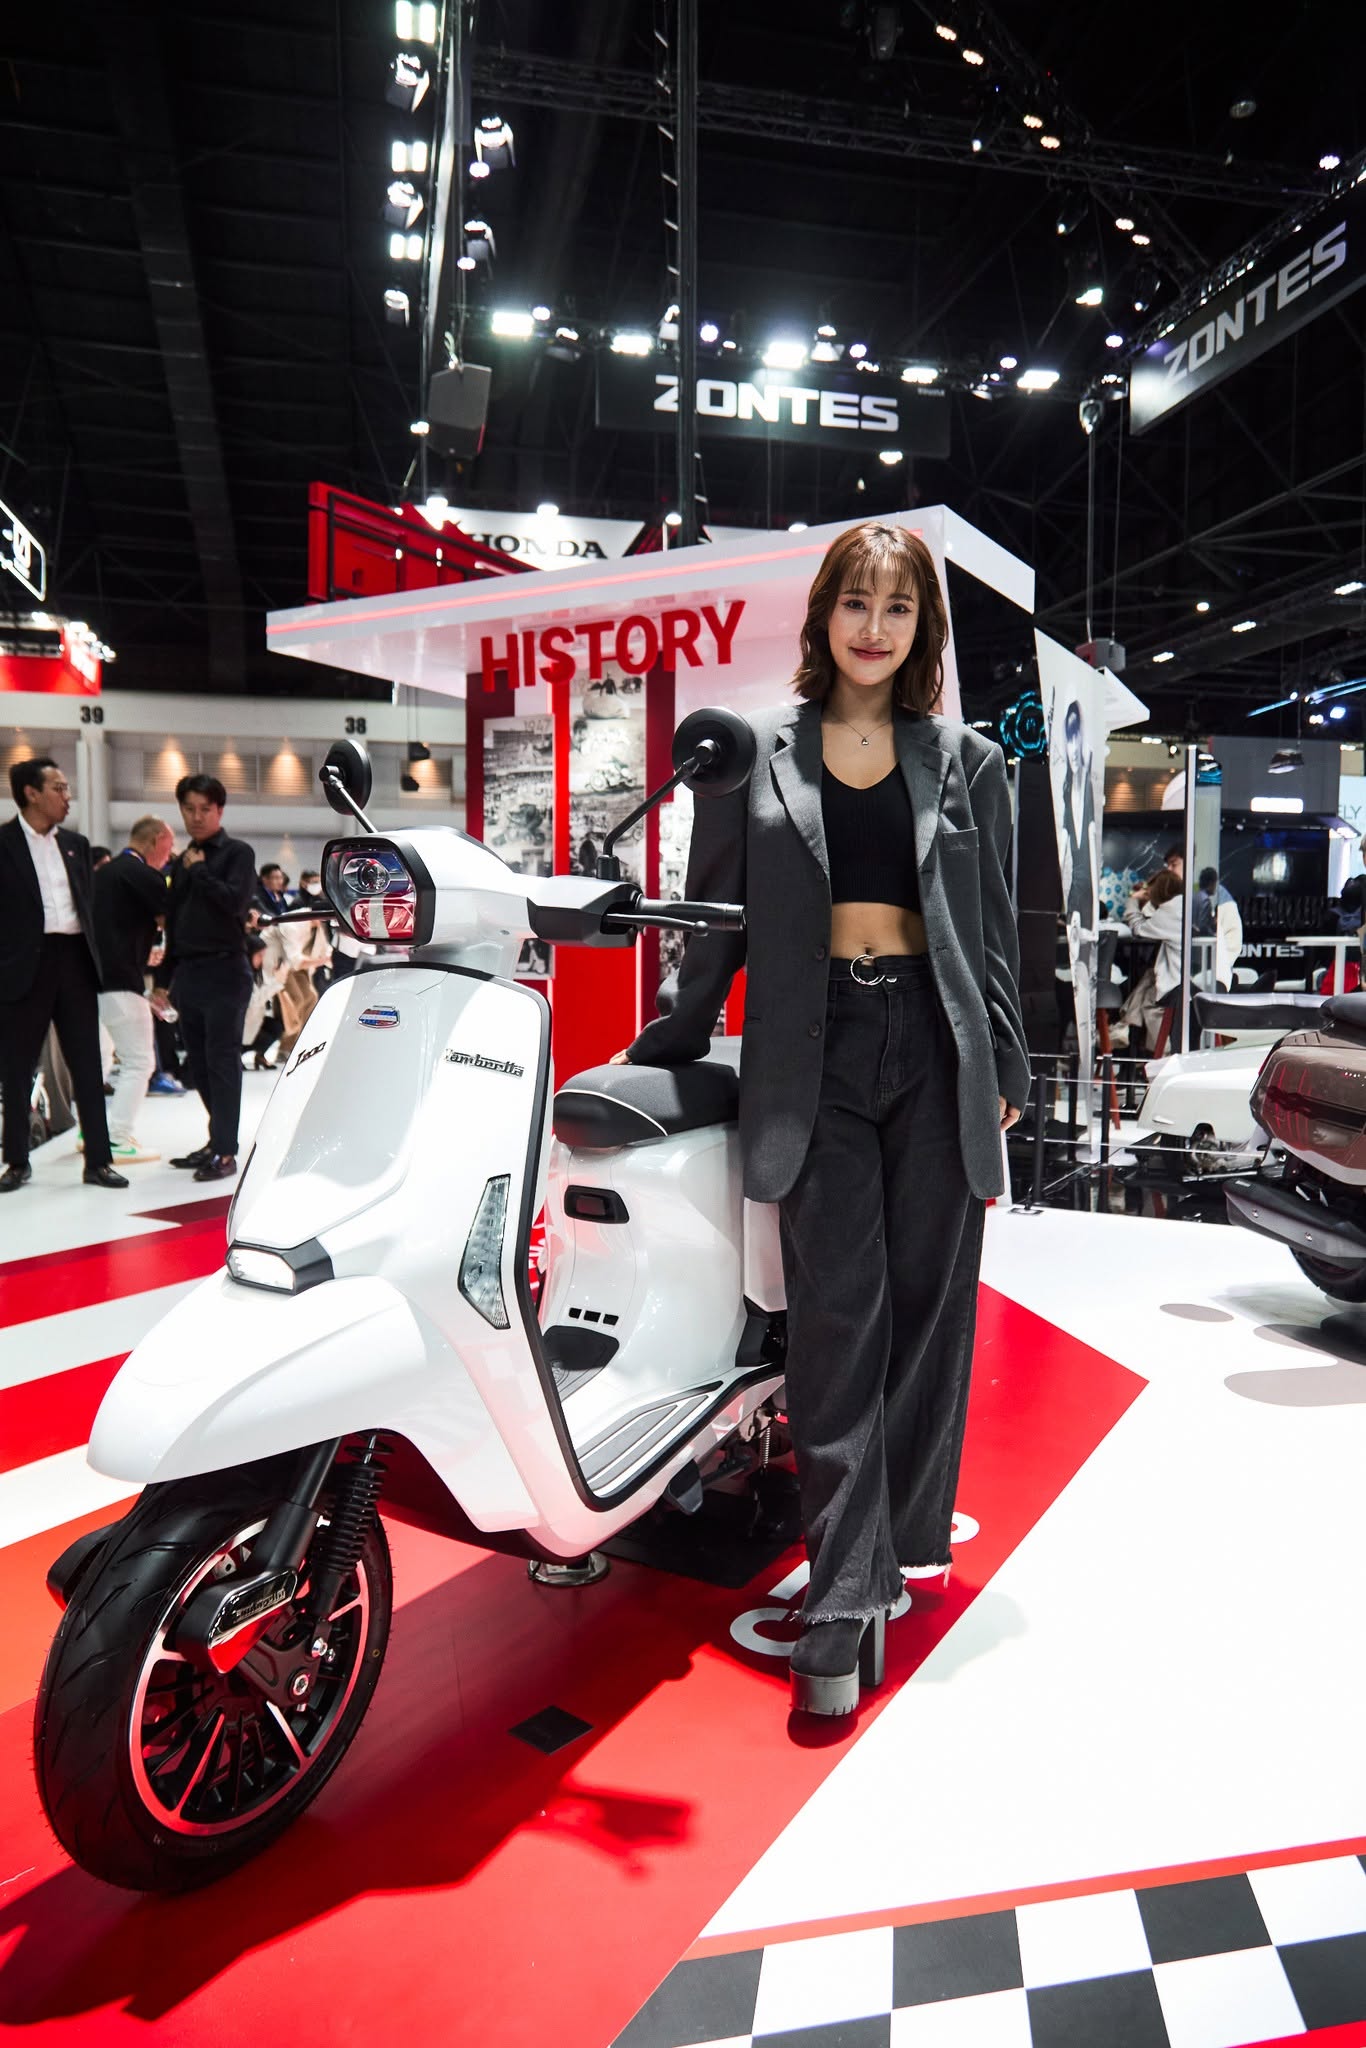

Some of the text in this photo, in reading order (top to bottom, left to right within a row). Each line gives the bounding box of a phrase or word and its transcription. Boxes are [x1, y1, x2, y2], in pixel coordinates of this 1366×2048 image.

[1163, 220, 1347, 388] ZONTES
[654, 375, 899, 432] ZONTES
[469, 533, 608, 560] HONDA
[480, 600, 746, 693] HISTORY
[80, 705, 104, 725] 39
[345, 716, 367, 735] 38
